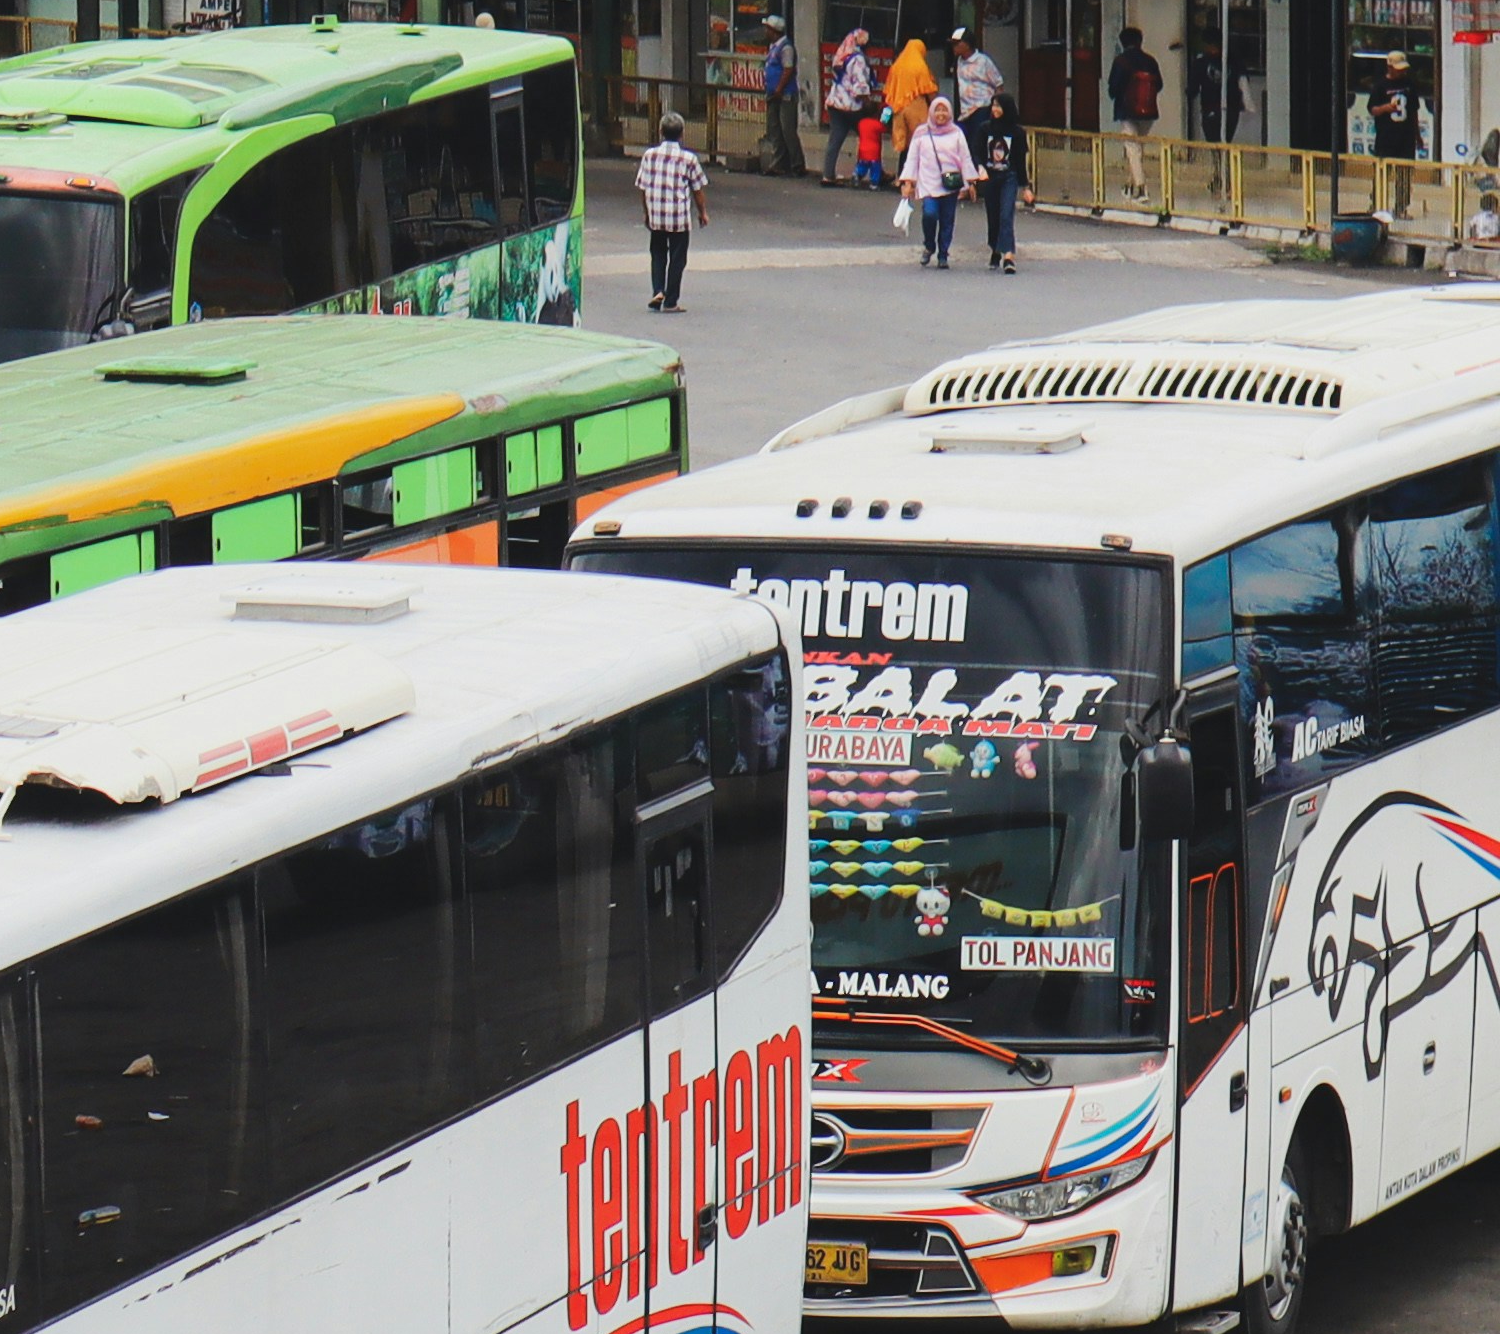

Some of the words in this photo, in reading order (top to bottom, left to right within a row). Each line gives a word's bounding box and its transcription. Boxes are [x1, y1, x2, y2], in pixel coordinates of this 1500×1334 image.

[1291, 716, 1318, 763] AC
[1315, 723, 1339, 752] TARIF
[1339, 715, 1365, 744] BIASA
[963, 940, 1006, 967] TOL
[1012, 940, 1113, 969] PANJANG
[837, 971, 950, 1000] MALANG
[560, 1023, 803, 1333] tentrem
